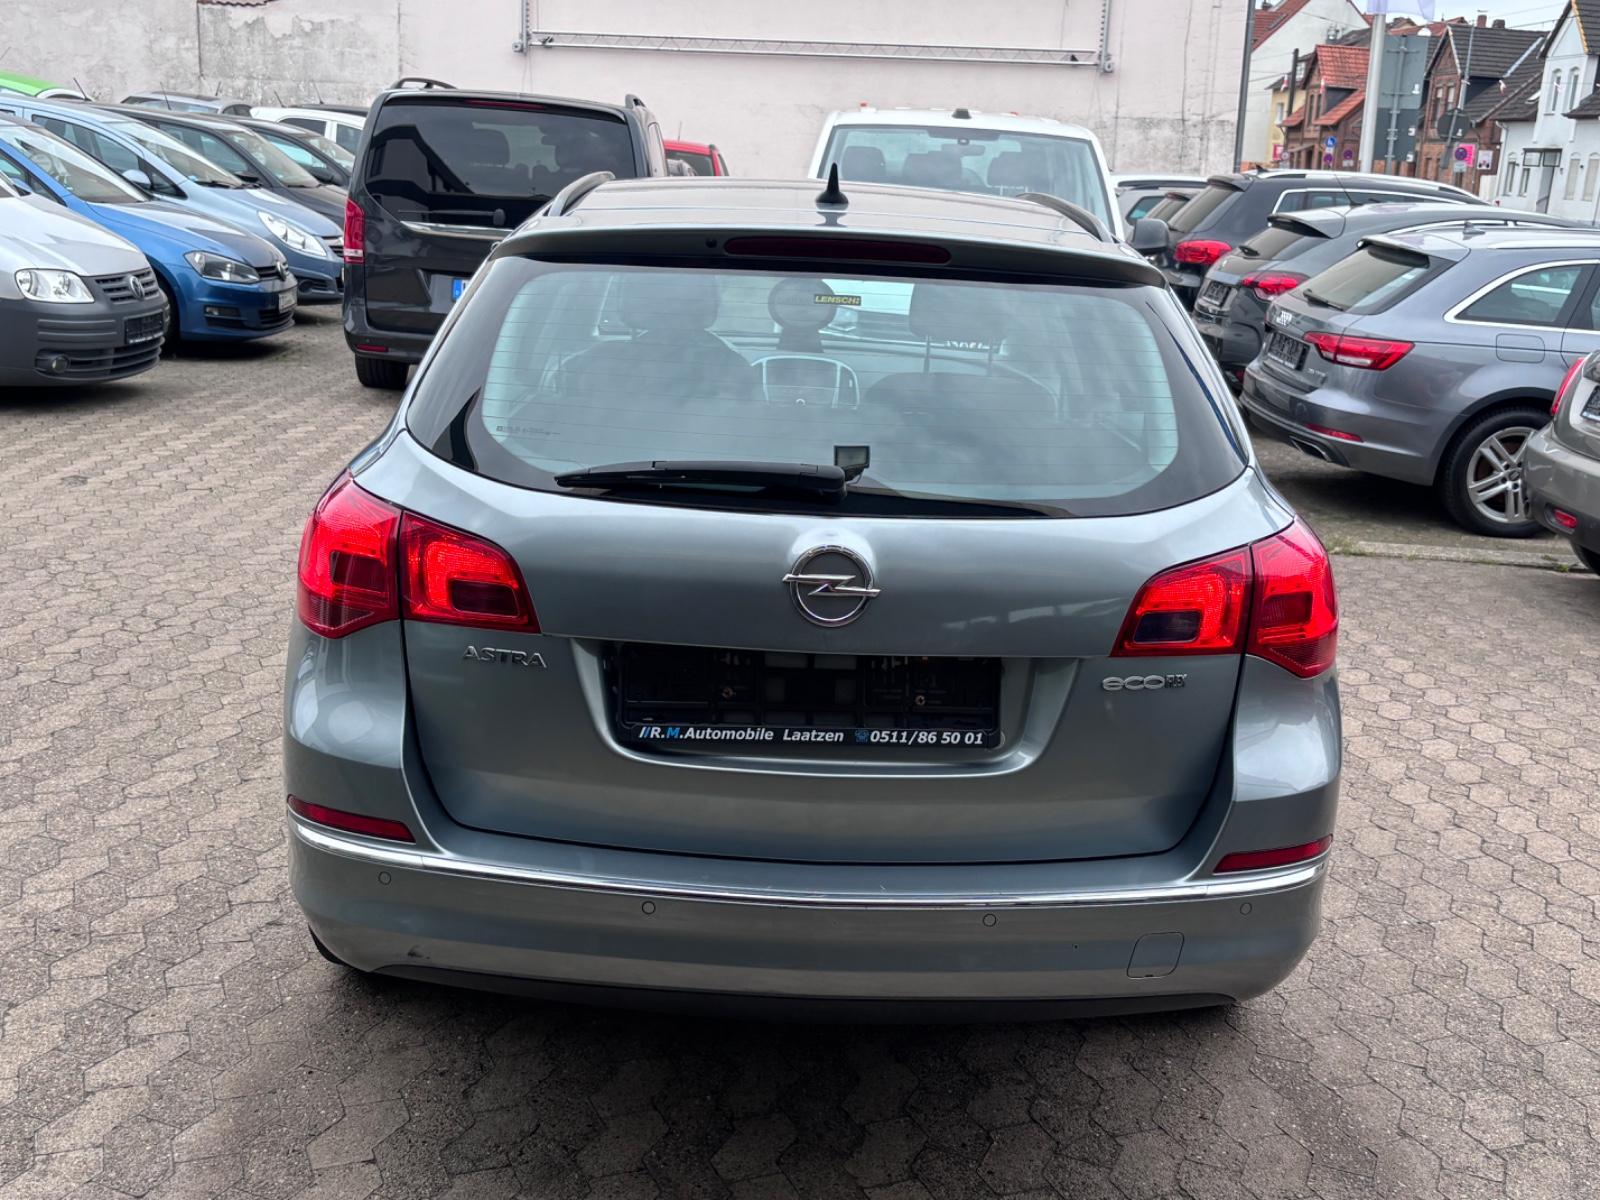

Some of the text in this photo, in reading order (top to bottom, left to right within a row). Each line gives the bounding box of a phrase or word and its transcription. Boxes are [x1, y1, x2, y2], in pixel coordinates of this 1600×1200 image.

[463, 645, 547, 668] ASTRA
[783, 729, 844, 743] Laatzen
[870, 731, 938, 745] 0511/86
[940, 732, 960, 744] 50
[964, 733, 983, 745] 01
